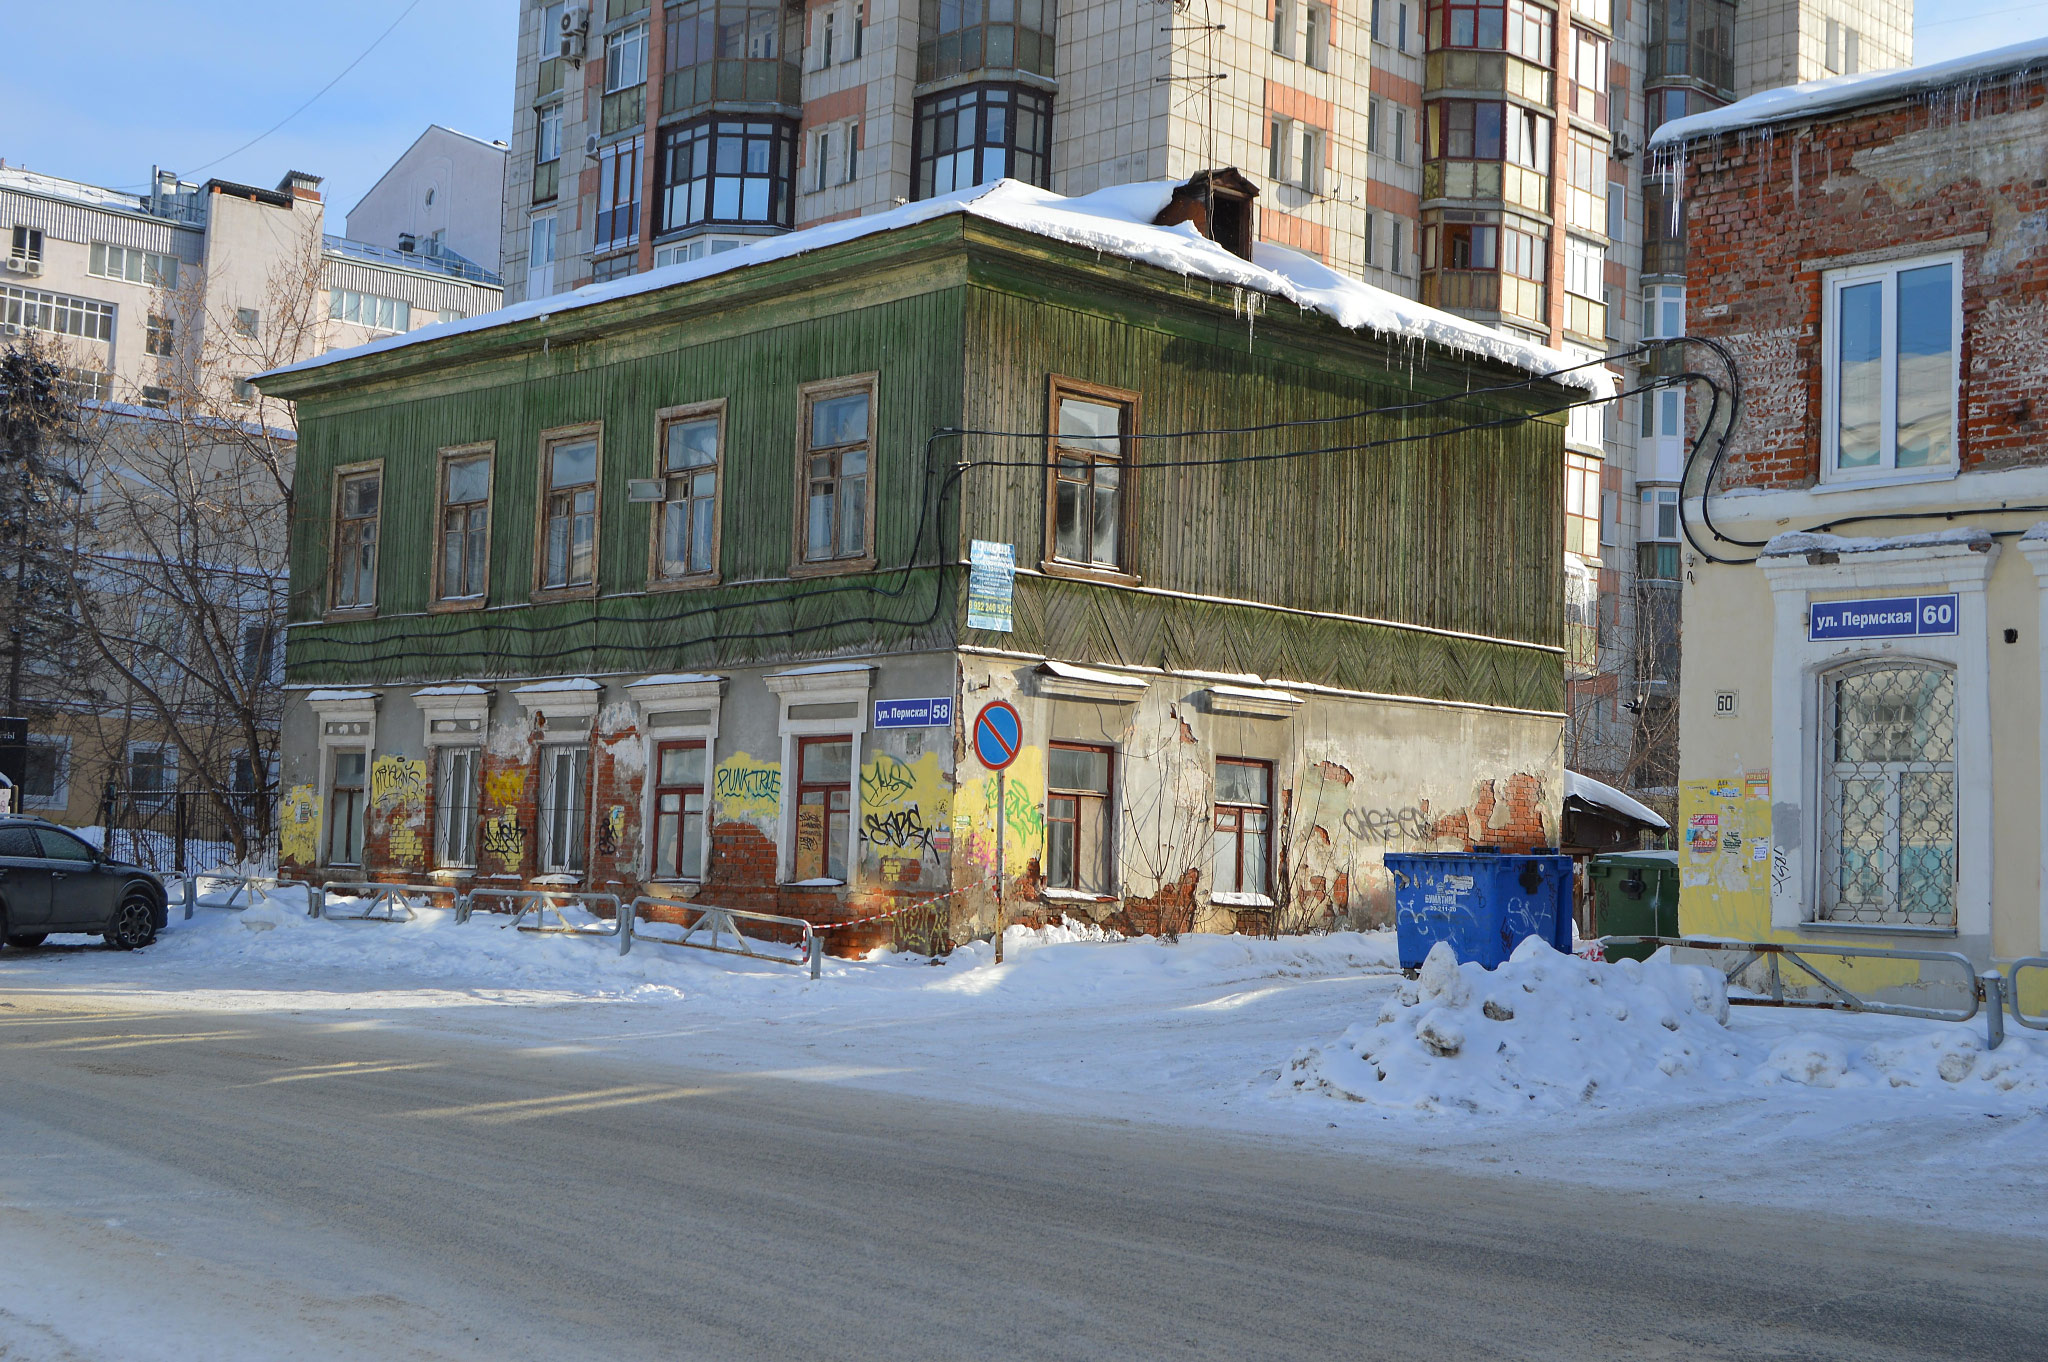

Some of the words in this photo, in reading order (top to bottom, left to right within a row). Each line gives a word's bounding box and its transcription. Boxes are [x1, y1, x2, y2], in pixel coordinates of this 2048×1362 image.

[974, 600, 985, 611] 922
[1816, 615, 1838, 631] ул.
[1842, 611, 1912, 629] Пермская
[1922, 604, 1952, 625] 60
[1717, 695, 1733, 711] 60
[877, 710, 890, 722] ул.
[891, 707, 928, 721] Пермская
[932, 704, 948, 719] 58
[717, 767, 751, 795] PUNK
[750, 768, 782, 794] TRUE
